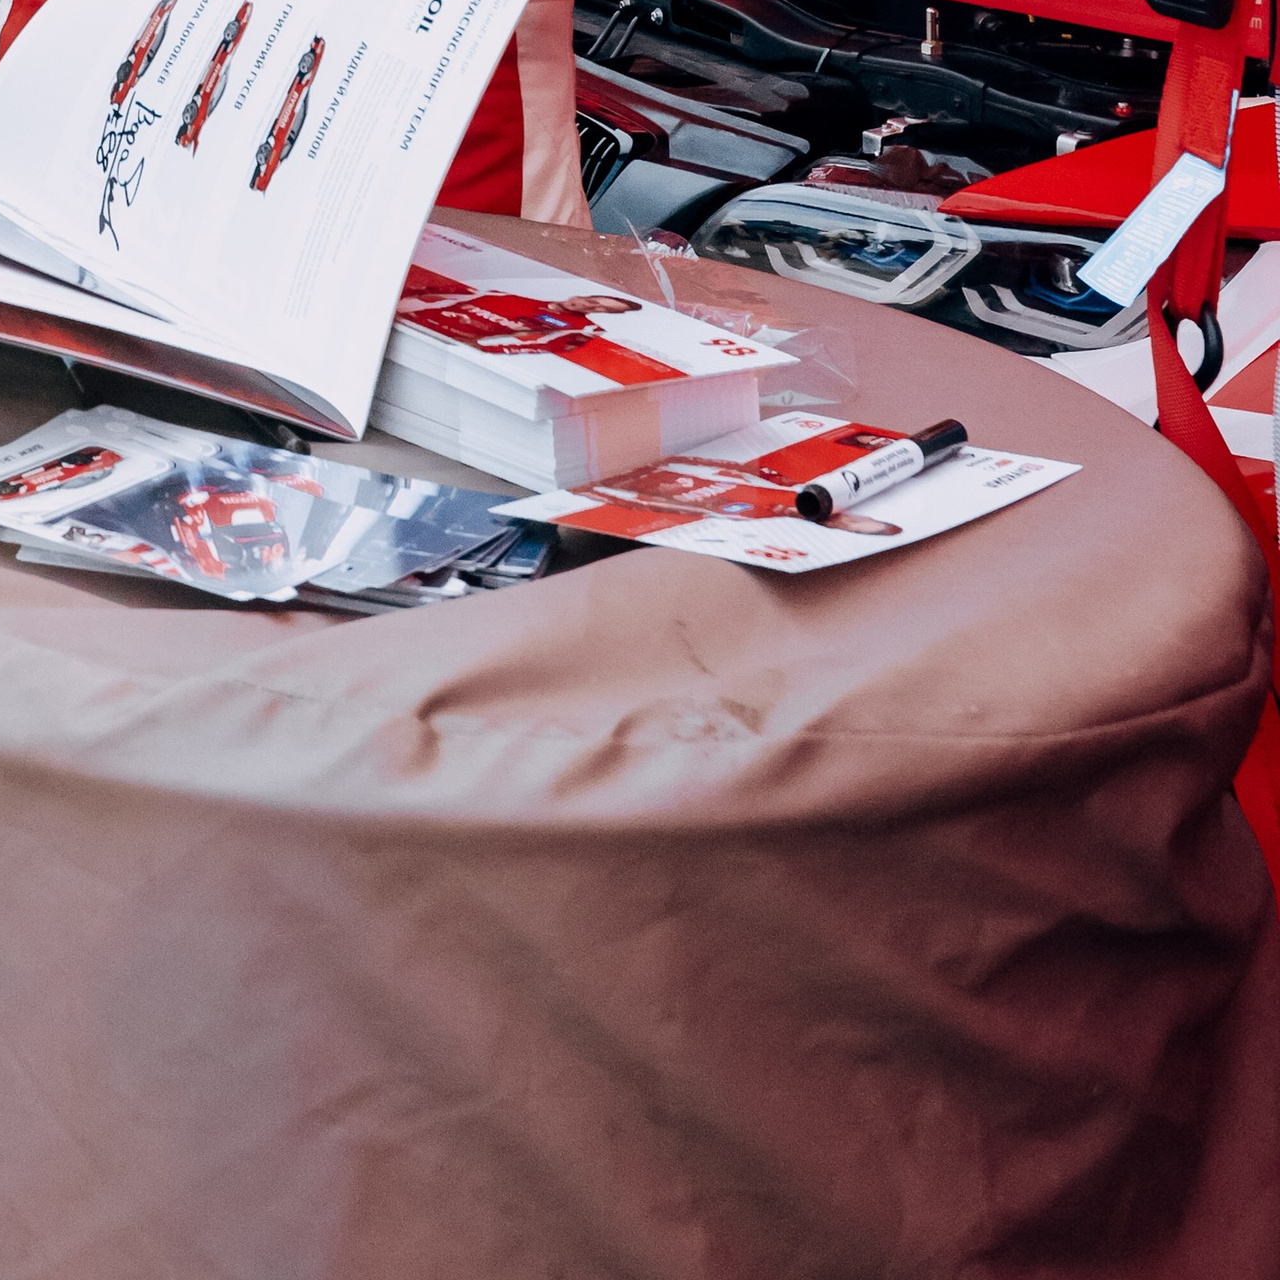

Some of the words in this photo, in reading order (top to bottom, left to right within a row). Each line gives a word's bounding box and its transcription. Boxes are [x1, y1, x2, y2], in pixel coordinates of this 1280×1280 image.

[157, 22, 194, 83] ВОРОБЬЁВ
[254, 4, 292, 69] ГРИГОРИЙ
[234, 71, 257, 110] ГУСЕВ
[337, 41, 367, 95] АНДРЕЙ
[424, 56, 450, 102] DRIFT
[308, 97, 339, 158] АСТАПОВ
[400, 107, 427, 150] TEAM
